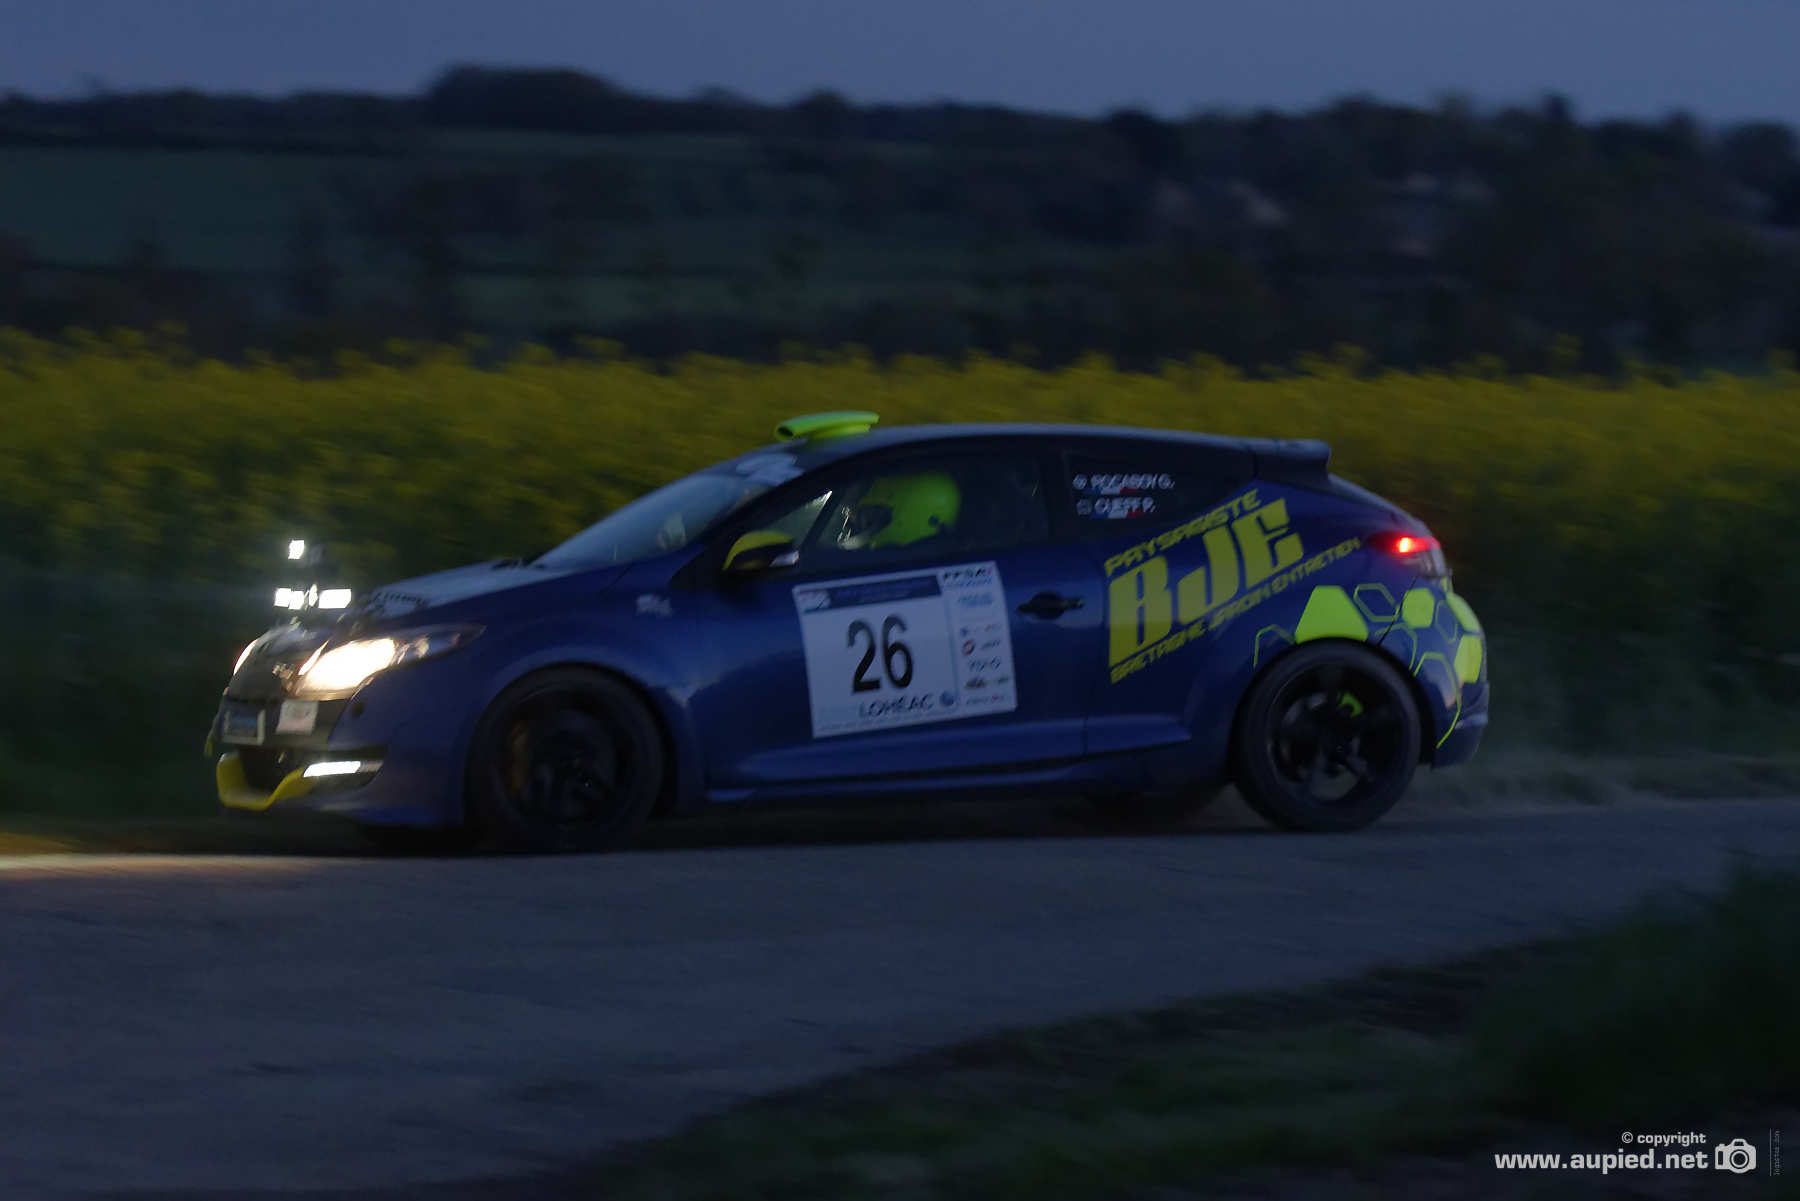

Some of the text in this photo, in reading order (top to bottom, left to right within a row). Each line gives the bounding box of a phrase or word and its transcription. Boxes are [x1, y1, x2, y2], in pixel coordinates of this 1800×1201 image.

[1104, 488, 1262, 577] PAYSAGISTE
[1108, 497, 1305, 668] BJE
[846, 614, 913, 694] 26
